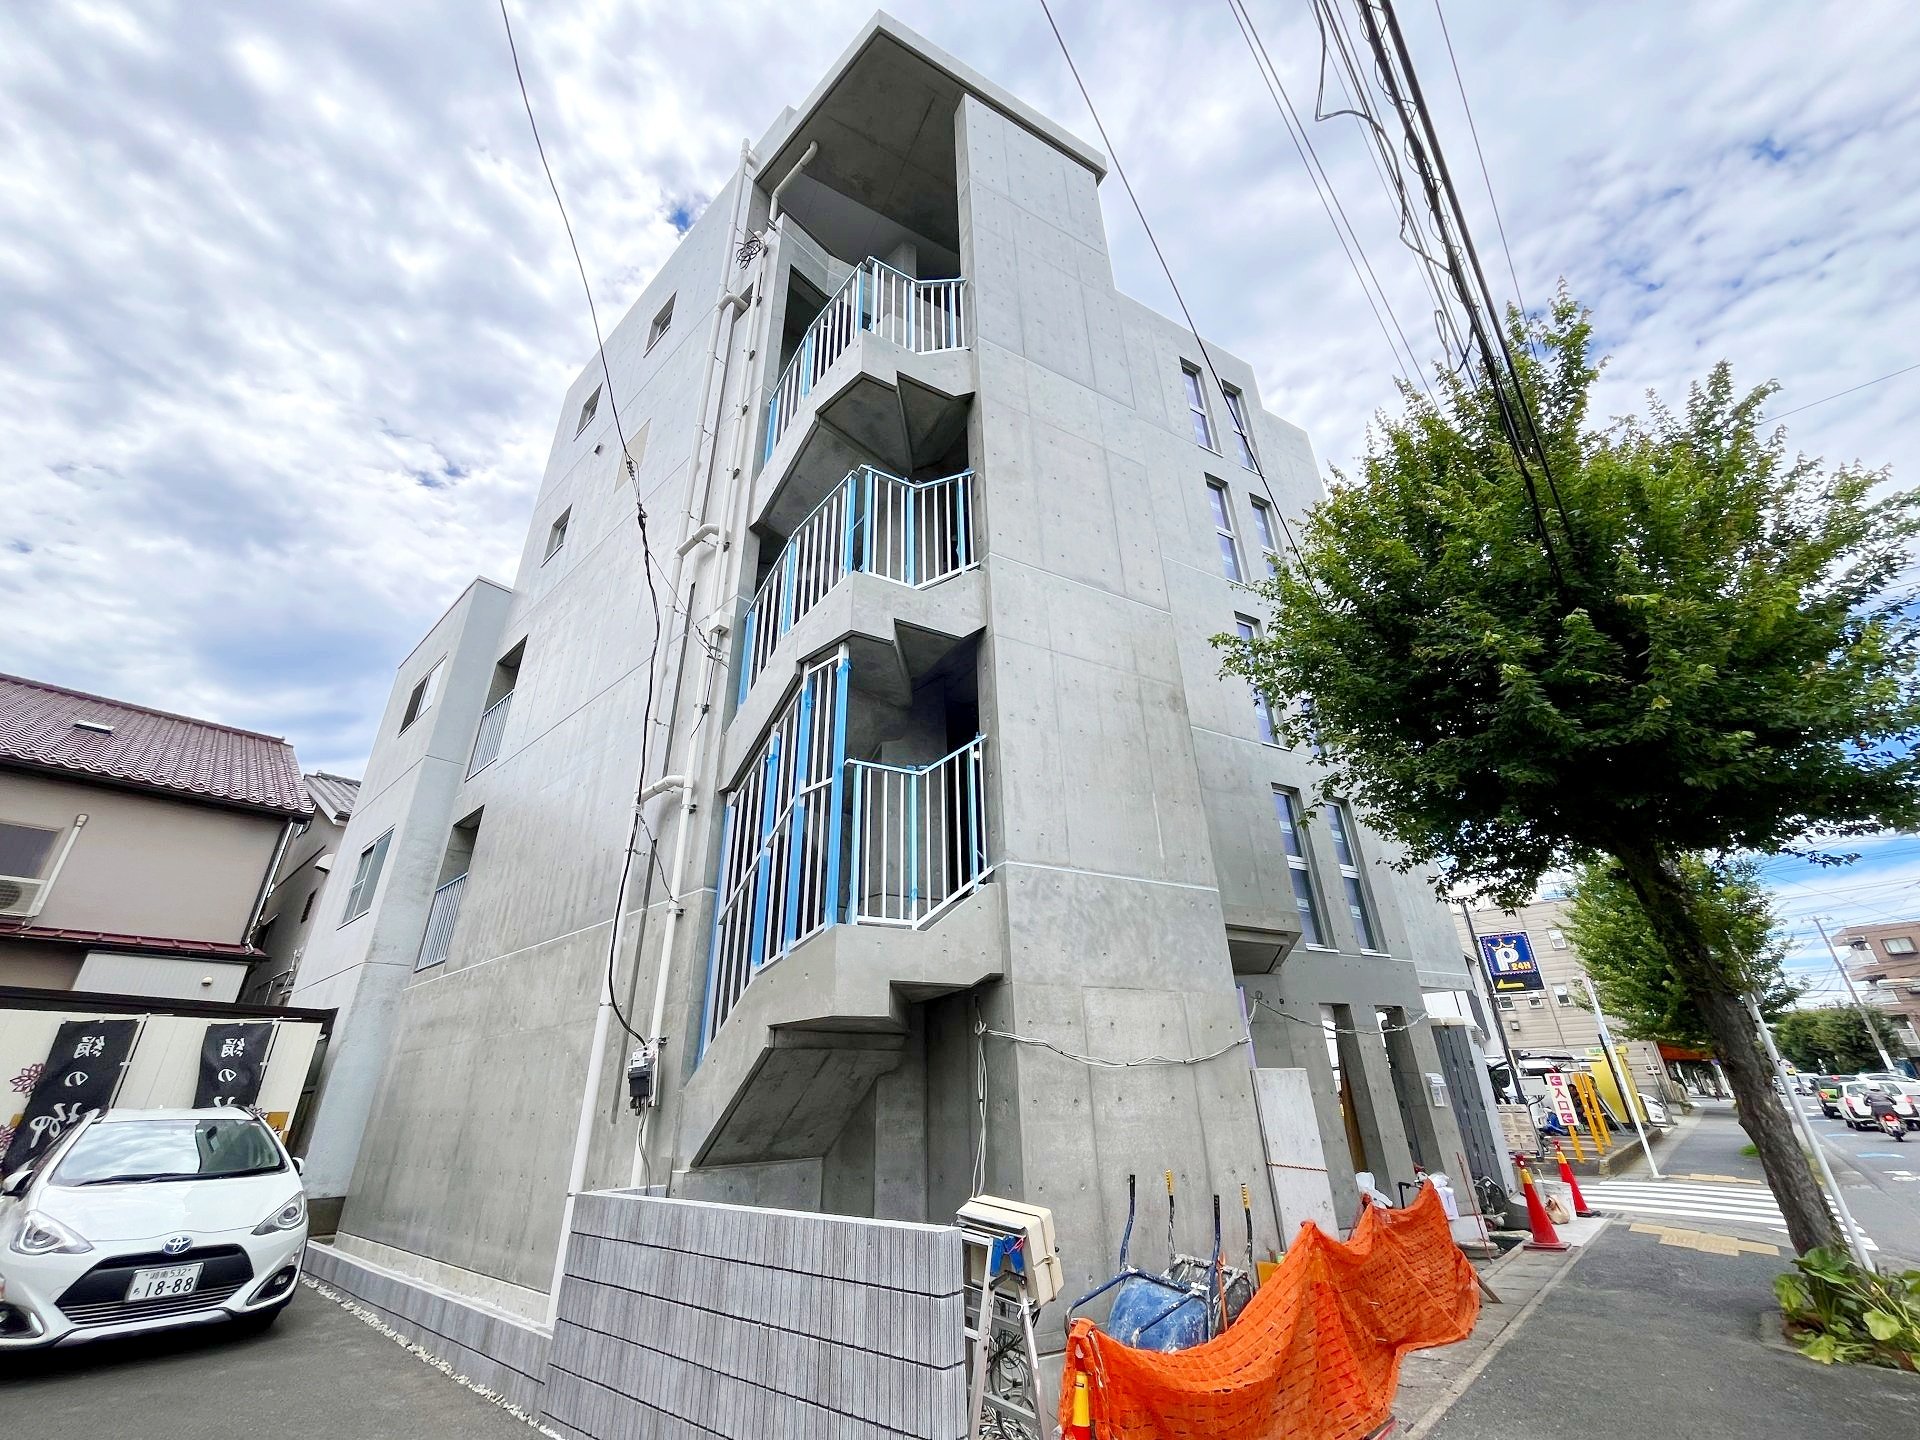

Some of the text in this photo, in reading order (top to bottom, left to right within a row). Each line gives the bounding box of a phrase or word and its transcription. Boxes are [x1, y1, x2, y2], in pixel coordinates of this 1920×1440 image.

[1495, 947, 1519, 971] P
[1511, 961, 1532, 971] 24H
[1554, 1087, 1570, 1111] 入口
[145, 1277, 194, 1298] 18-88
